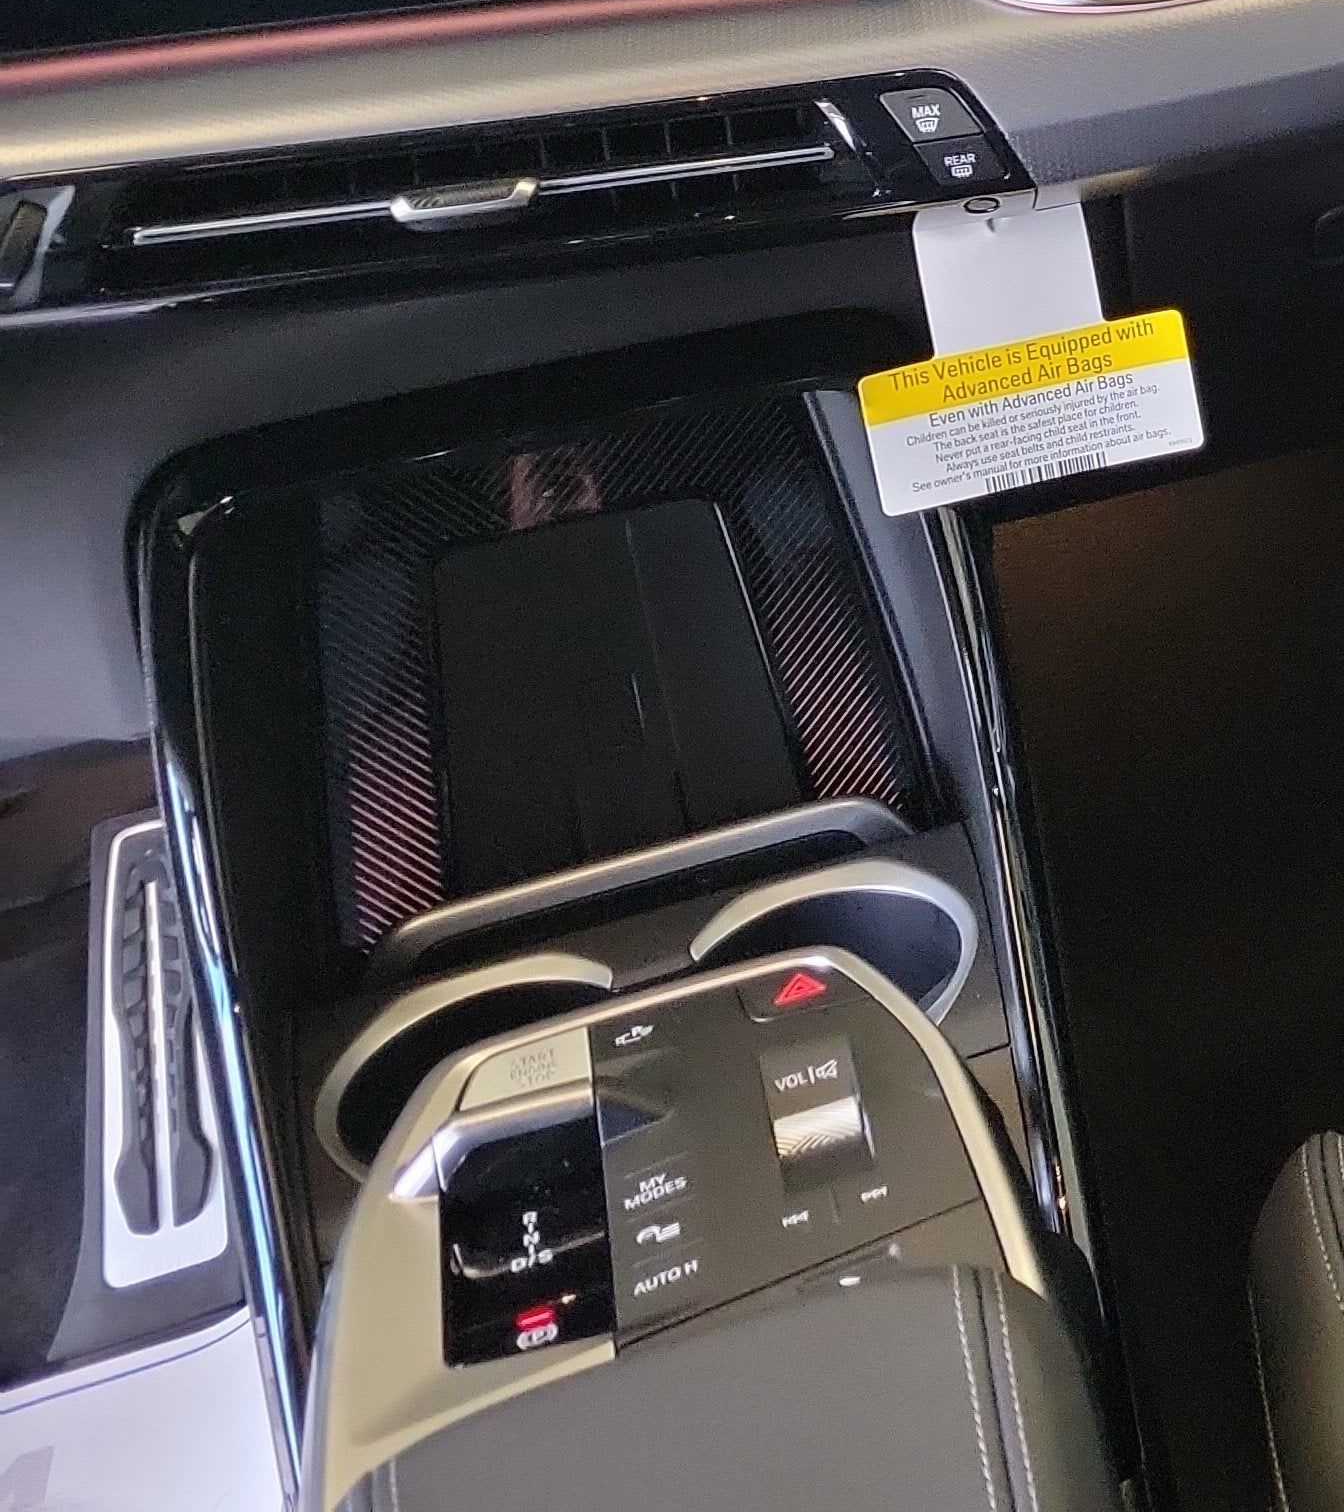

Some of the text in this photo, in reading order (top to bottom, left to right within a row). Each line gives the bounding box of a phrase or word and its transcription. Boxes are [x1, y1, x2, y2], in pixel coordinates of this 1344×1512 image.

[911, 103, 941, 119] MAX
[943, 152, 977, 167] REAR
[888, 319, 1154, 391] This Vehicle is Equipped with
[942, 354, 1113, 403] Advanced Air Bags
[906, 429, 948, 447] Children
[949, 426, 967, 437] can
[968, 421, 981, 433] be
[982, 415, 1007, 429] killed
[1009, 414, 1019, 424] or
[1020, 402, 1061, 421] seriously
[1063, 394, 1095, 411] injured
[1097, 393, 1110, 407] by
[1110, 389, 1126, 402] the
[1127, 386, 1138, 398] air
[929, 373, 1133, 427] Even with Advanced Air Bags
[934, 399, 1140, 451] The back seat is the safest place for children.
[935, 410, 1141, 464] Never put a rear-facing child seat in the front.
[946, 423, 1136, 474] Always use seat belts and child restraints.
[912, 481, 932, 493] See
[934, 471, 971, 487] owner's
[973, 463, 1008, 479] manual
[1009, 459, 1022, 471] for
[1024, 454, 1049, 467] more
[1050, 441, 1103, 460] information
[1105, 434, 1131, 448] about
[1133, 431, 1144, 442] air
[774, 1071, 809, 1092] VOL
[623, 1176, 687, 1210] MODES
[639, 1173, 666, 1192] MY
[522, 1231, 540, 1247] N
[633, 1259, 698, 1298] AUTO H
